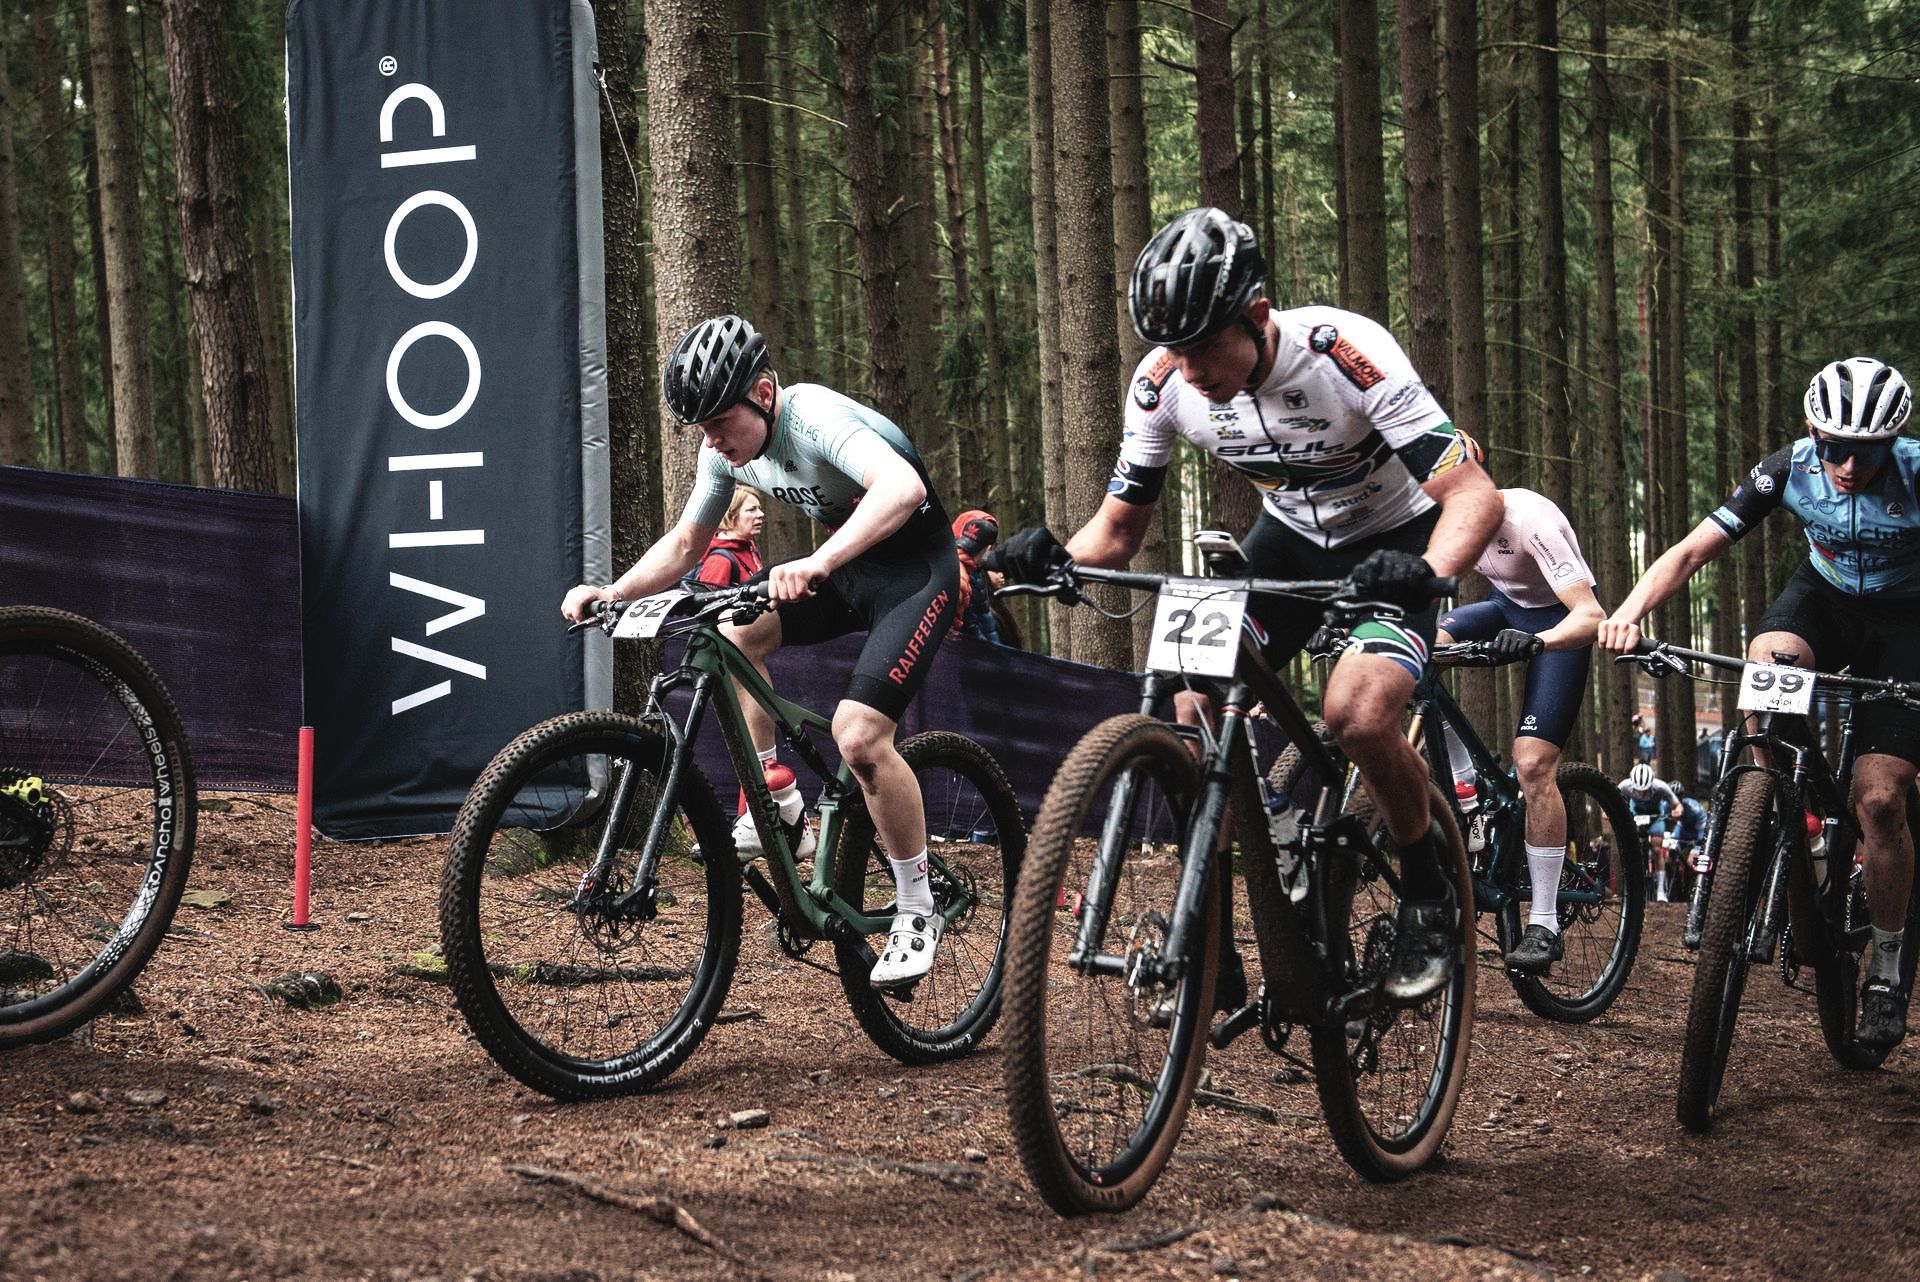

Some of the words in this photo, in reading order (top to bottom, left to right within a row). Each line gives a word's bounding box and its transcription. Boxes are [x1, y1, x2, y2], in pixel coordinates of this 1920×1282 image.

[1340, 340, 1379, 382] VALMOR
[380, 83, 486, 715] WHOOP
[805, 425, 820, 442] AG
[1216, 440, 1345, 457] SOUL
[772, 485, 834, 507] ROSE
[629, 600, 671, 618] 52
[889, 590, 949, 685] RAIFFEISEN
[1163, 609, 1230, 647] 22
[1751, 670, 1804, 693] 99
[145, 727, 170, 796] wheels
[604, 1058, 623, 1072] DT
[626, 1040, 660, 1067] SWISS
[912, 1038, 954, 1053] RALPH
[578, 1066, 643, 1084] RACING
[644, 1043, 676, 1072] RAY
